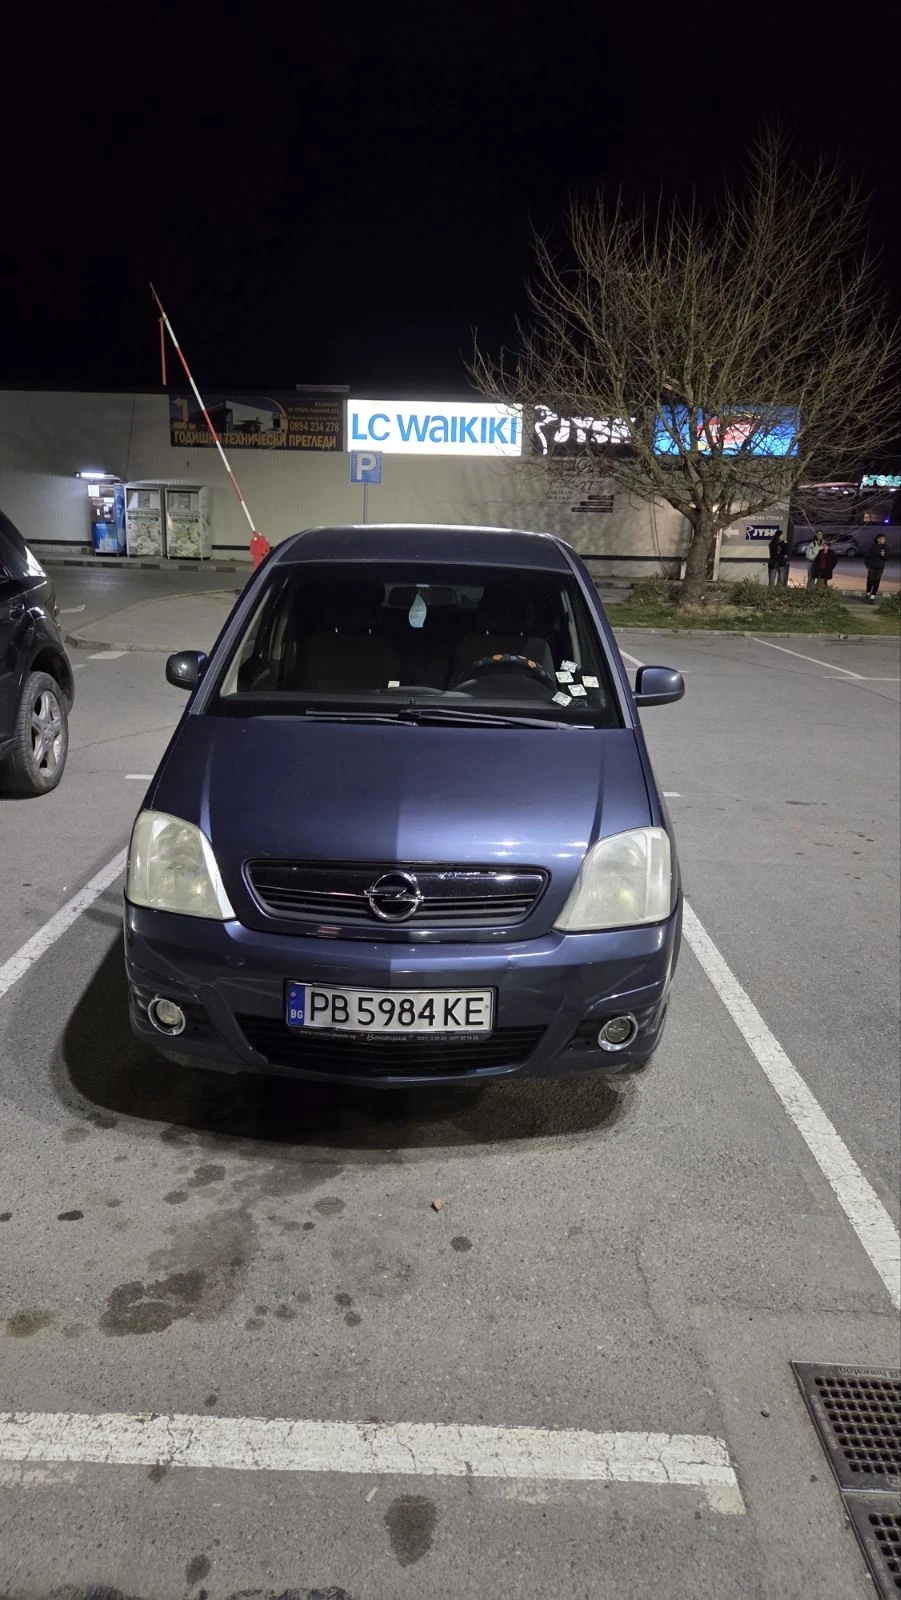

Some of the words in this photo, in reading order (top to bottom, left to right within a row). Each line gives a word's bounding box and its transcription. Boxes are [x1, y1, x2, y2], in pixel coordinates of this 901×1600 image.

[310, 421, 323, 432] 234
[326, 422, 339, 432] 278
[352, 413, 391, 441] LC
[224, 432, 286, 447] ТЕХНИЧЕСКИ
[289, 435, 336, 449] ПРЕГЛЕДИ
[356, 454, 377, 480] P
[290, 1009, 304, 1019] BG
[309, 992, 349, 1023] PB
[357, 997, 436, 1026] 5984
[443, 997, 484, 1026] KE
